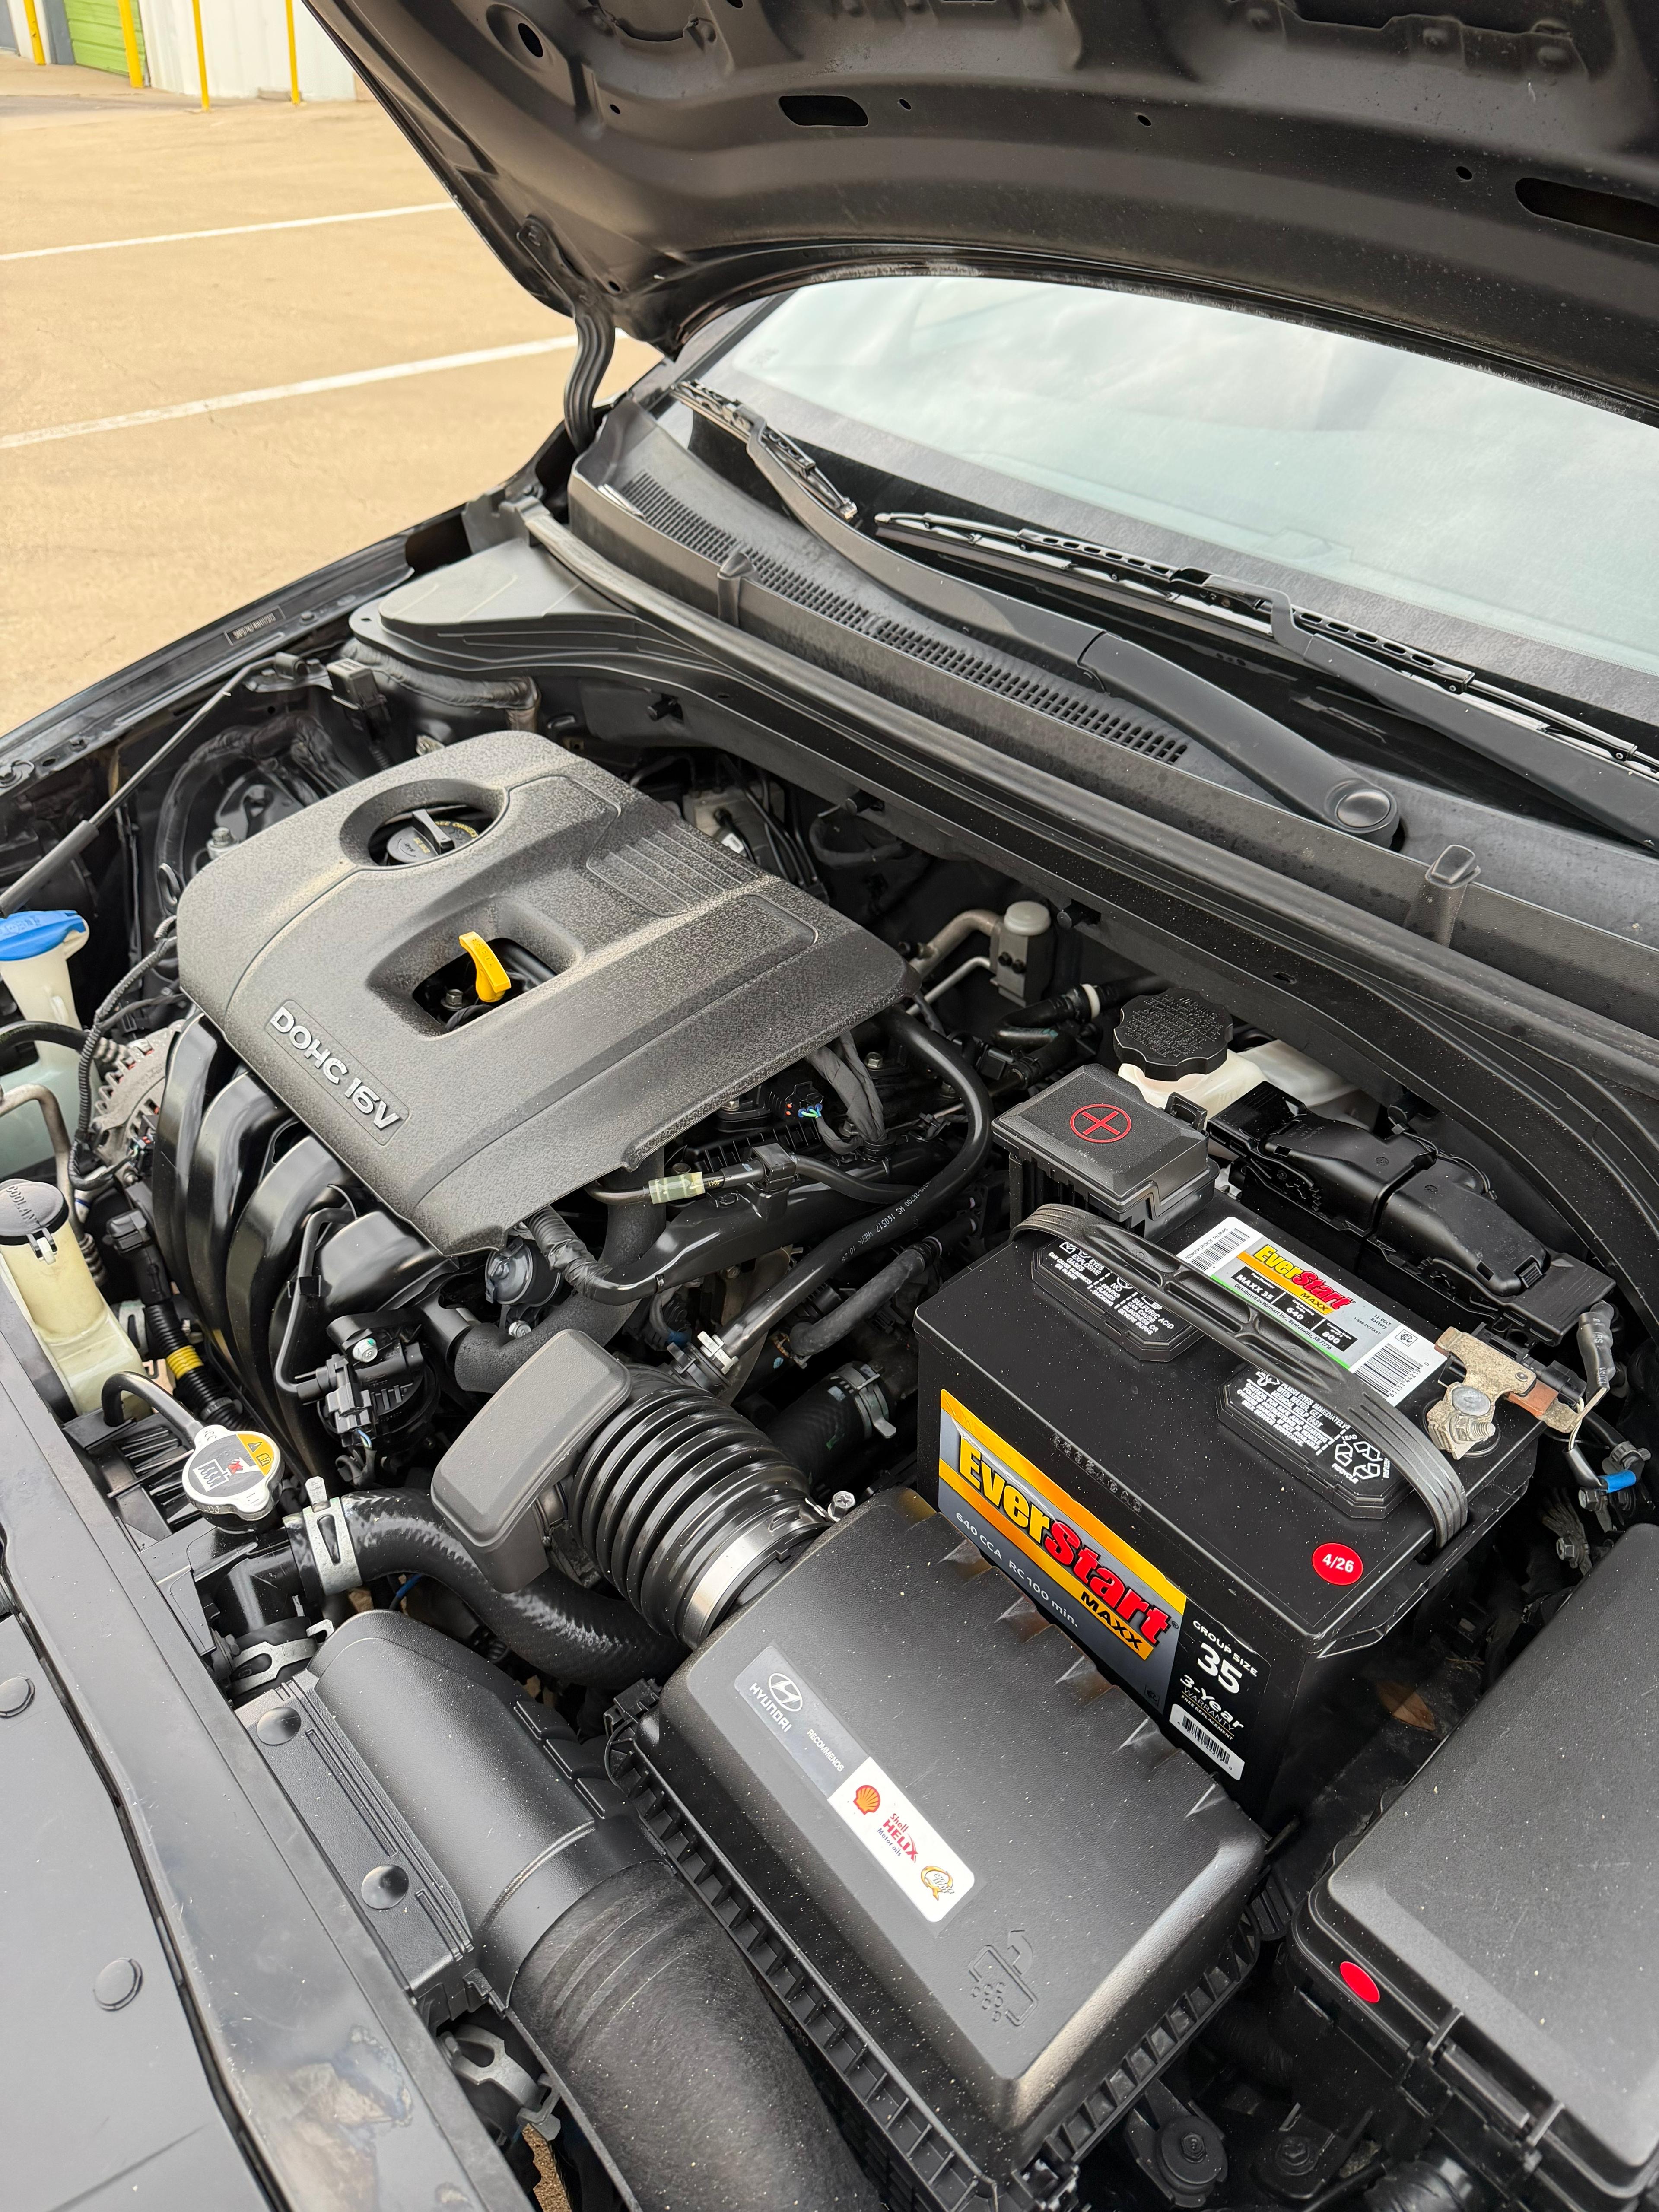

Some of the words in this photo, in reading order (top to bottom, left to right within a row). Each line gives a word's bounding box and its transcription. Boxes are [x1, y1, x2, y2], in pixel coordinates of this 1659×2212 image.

[270, 1006, 348, 1085] DOHC
[345, 1077, 401, 1130] 16V
[896, 1206, 905, 1215] HS
[1066, 1258, 1085, 1272] GASES
[1072, 1254, 1102, 1276] EXPLOSIVE
[1089, 1259, 1105, 1270] EYES
[1253, 1244, 1354, 1310] EverStart
[1110, 1283, 1122, 1292] NO
[1236, 1274, 1263, 1293] MAXX
[1261, 1290, 1274, 1300] 35
[1122, 1305, 1150, 1326] BLINDNESS
[1127, 1302, 1139, 1311] CAN
[1138, 1309, 1156, 1323] CAUSE
[1132, 1298, 1160, 1319] SULFURIC
[1158, 1318, 1175, 1329] ACID
[1286, 1307, 1304, 1320] 640
[1300, 1292, 1328, 1312] MAXX
[1118, 1308, 1137, 1323] SEVERE
[1135, 1321, 1153, 1335] BURNS
[1234, 1284, 1257, 1301] Distributed
[1262, 1300, 1280, 1315] Walmart
[1288, 1319, 1313, 1338] Bentonville,
[1320, 1340, 1332, 1350] 72716
[1370, 1317, 1388, 1330] Battery
[1374, 1314, 1392, 1326] 12-VOLT
[1322, 1332, 1340, 1344] 800
[1271, 1391, 1293, 1408] MEDICAL
[1293, 1405, 1308, 1418] HELP
[1307, 1415, 1324, 1428] FAST
[1276, 1387, 1291, 1399] WITH
[1309, 1408, 1323, 1419] GET
[1298, 1393, 1314, 1405] EYES
[1332, 1463, 1359, 1484] RECYCLE
[960, 1436, 1171, 1646] EverStart
[956, 1512, 978, 1538] 640
[979, 1535, 1003, 1560] CCA
[1009, 1560, 1026, 1579] RC
[1027, 1576, 1050, 1601] 100
[1051, 1600, 1078, 1628] min.
[1322, 1553, 1354, 1573] 4/26
[1081, 1590, 1143, 1652] MAXX
[1193, 1620, 1232, 1654] GROUP
[1233, 1653, 1258, 1677] SIZE
[1197, 1642, 1243, 1694] 35
[750, 1683, 792, 1732] HYUNDAI
[1180, 1674, 1244, 1729] 3-Year
[1184, 1687, 1234, 1731] WARRANTY
[1181, 1695, 1195, 1710] FREE
[1195, 1705, 1234, 1740] REPLACEMENT
[807, 1729, 845, 1772] RECOMMENDS
[891, 1813, 909, 1833] Shell
[877, 1827, 893, 1848] Motor
[893, 1845, 902, 1857] oils
[883, 1818, 919, 1863] HELIX
